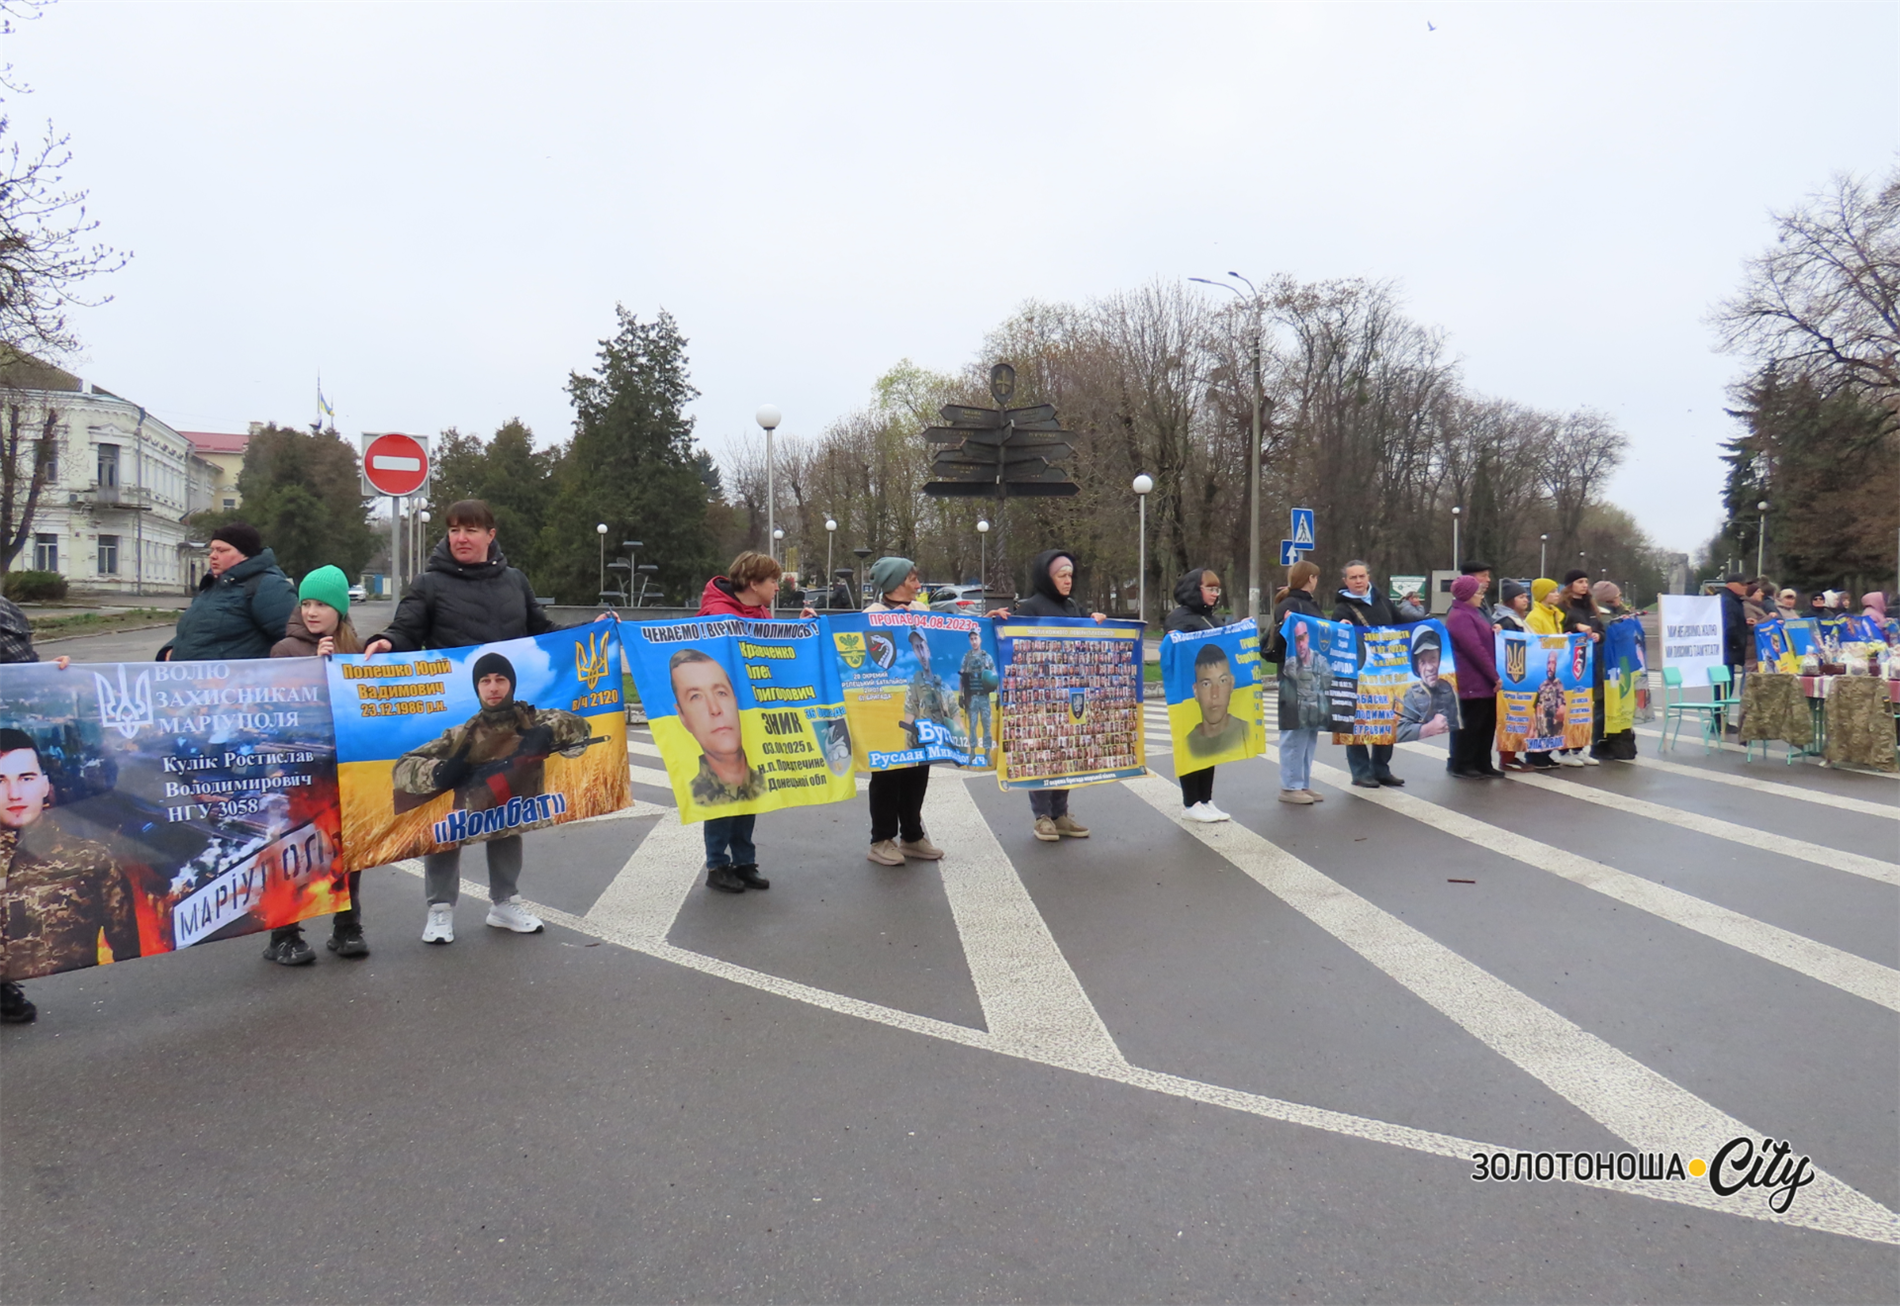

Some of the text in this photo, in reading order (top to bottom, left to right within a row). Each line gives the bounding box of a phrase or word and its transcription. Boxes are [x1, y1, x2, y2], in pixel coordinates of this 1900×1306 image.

[869, 613, 913, 626] ПРОПАВ
[641, 623, 700, 643] ЧЕКАЄМО
[753, 622, 813, 639] МОЛИМОСЬ
[738, 641, 796, 659] Кравченко
[154, 663, 230, 682] ВОЛЮ
[342, 658, 452, 679] Полешко Юрій
[745, 663, 773, 680] Олег
[155, 686, 318, 708] ЗАХИСНИКАМ
[357, 682, 445, 700] Вадимович
[590, 689, 619, 707] 2120
[751, 684, 817, 703] Григорович
[361, 700, 447, 717] 23.12.1986 р.н.
[159, 711, 299, 734] МАРІУПОЛЯ
[761, 712, 803, 735] ЗНИК
[1353, 725, 1392, 735] ЕТРОВИЧ
[762, 741, 806, 754] 03.012025
[162, 751, 314, 775] Кулік Ростислав
[870, 750, 924, 767] Руслан
[165, 774, 312, 797] Володимирович
[809, 773, 827, 786] обл
[168, 799, 258, 822] НГУ 3058
